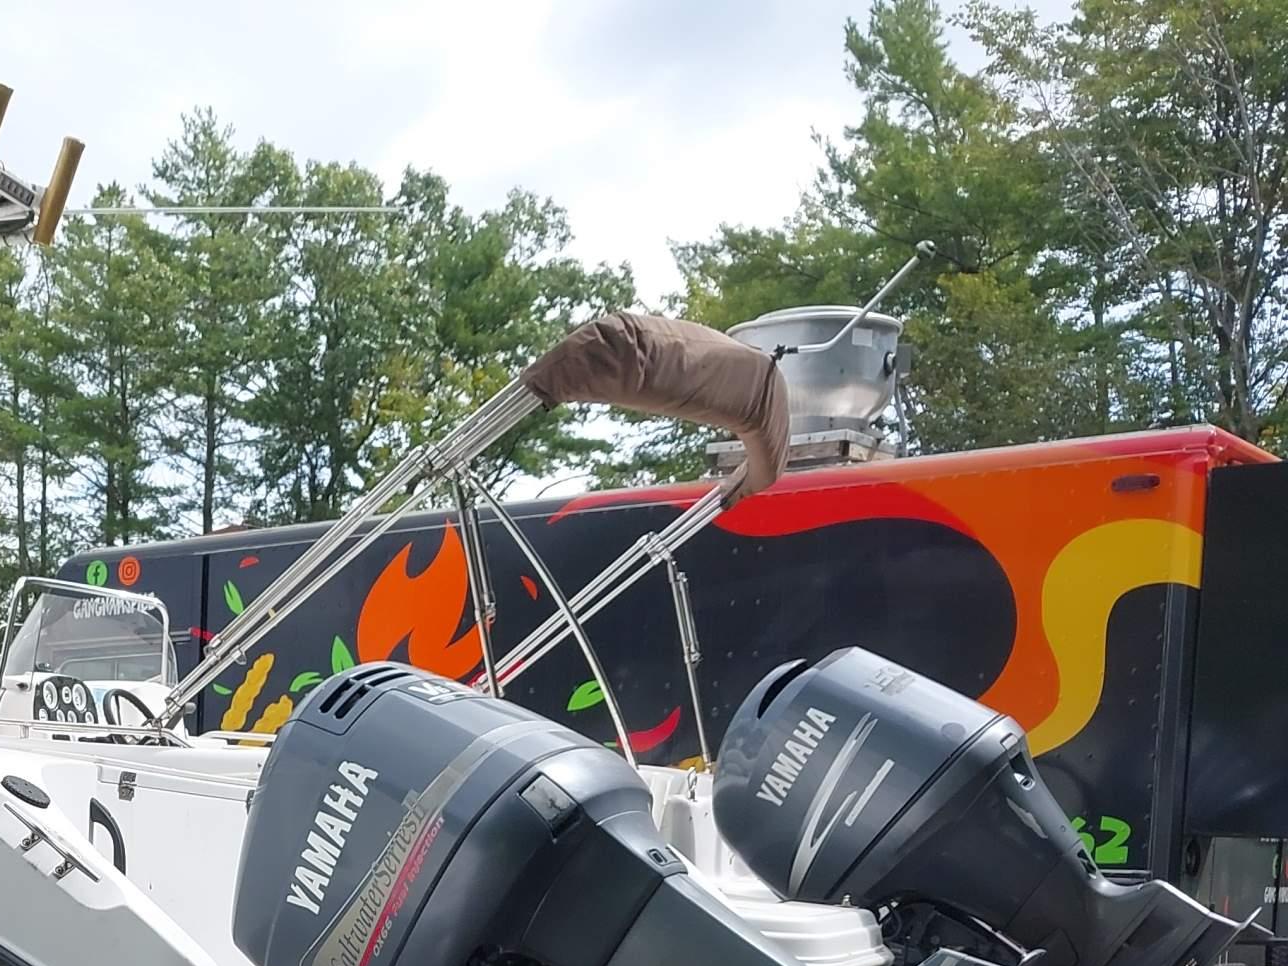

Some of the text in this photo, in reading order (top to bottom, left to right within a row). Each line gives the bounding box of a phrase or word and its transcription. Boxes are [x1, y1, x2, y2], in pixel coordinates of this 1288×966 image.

[756, 707, 838, 807] YAMAHA
[286, 759, 380, 916] YAMAHA
[374, 817, 418, 888] Series
[405, 815, 446, 884] Injection
